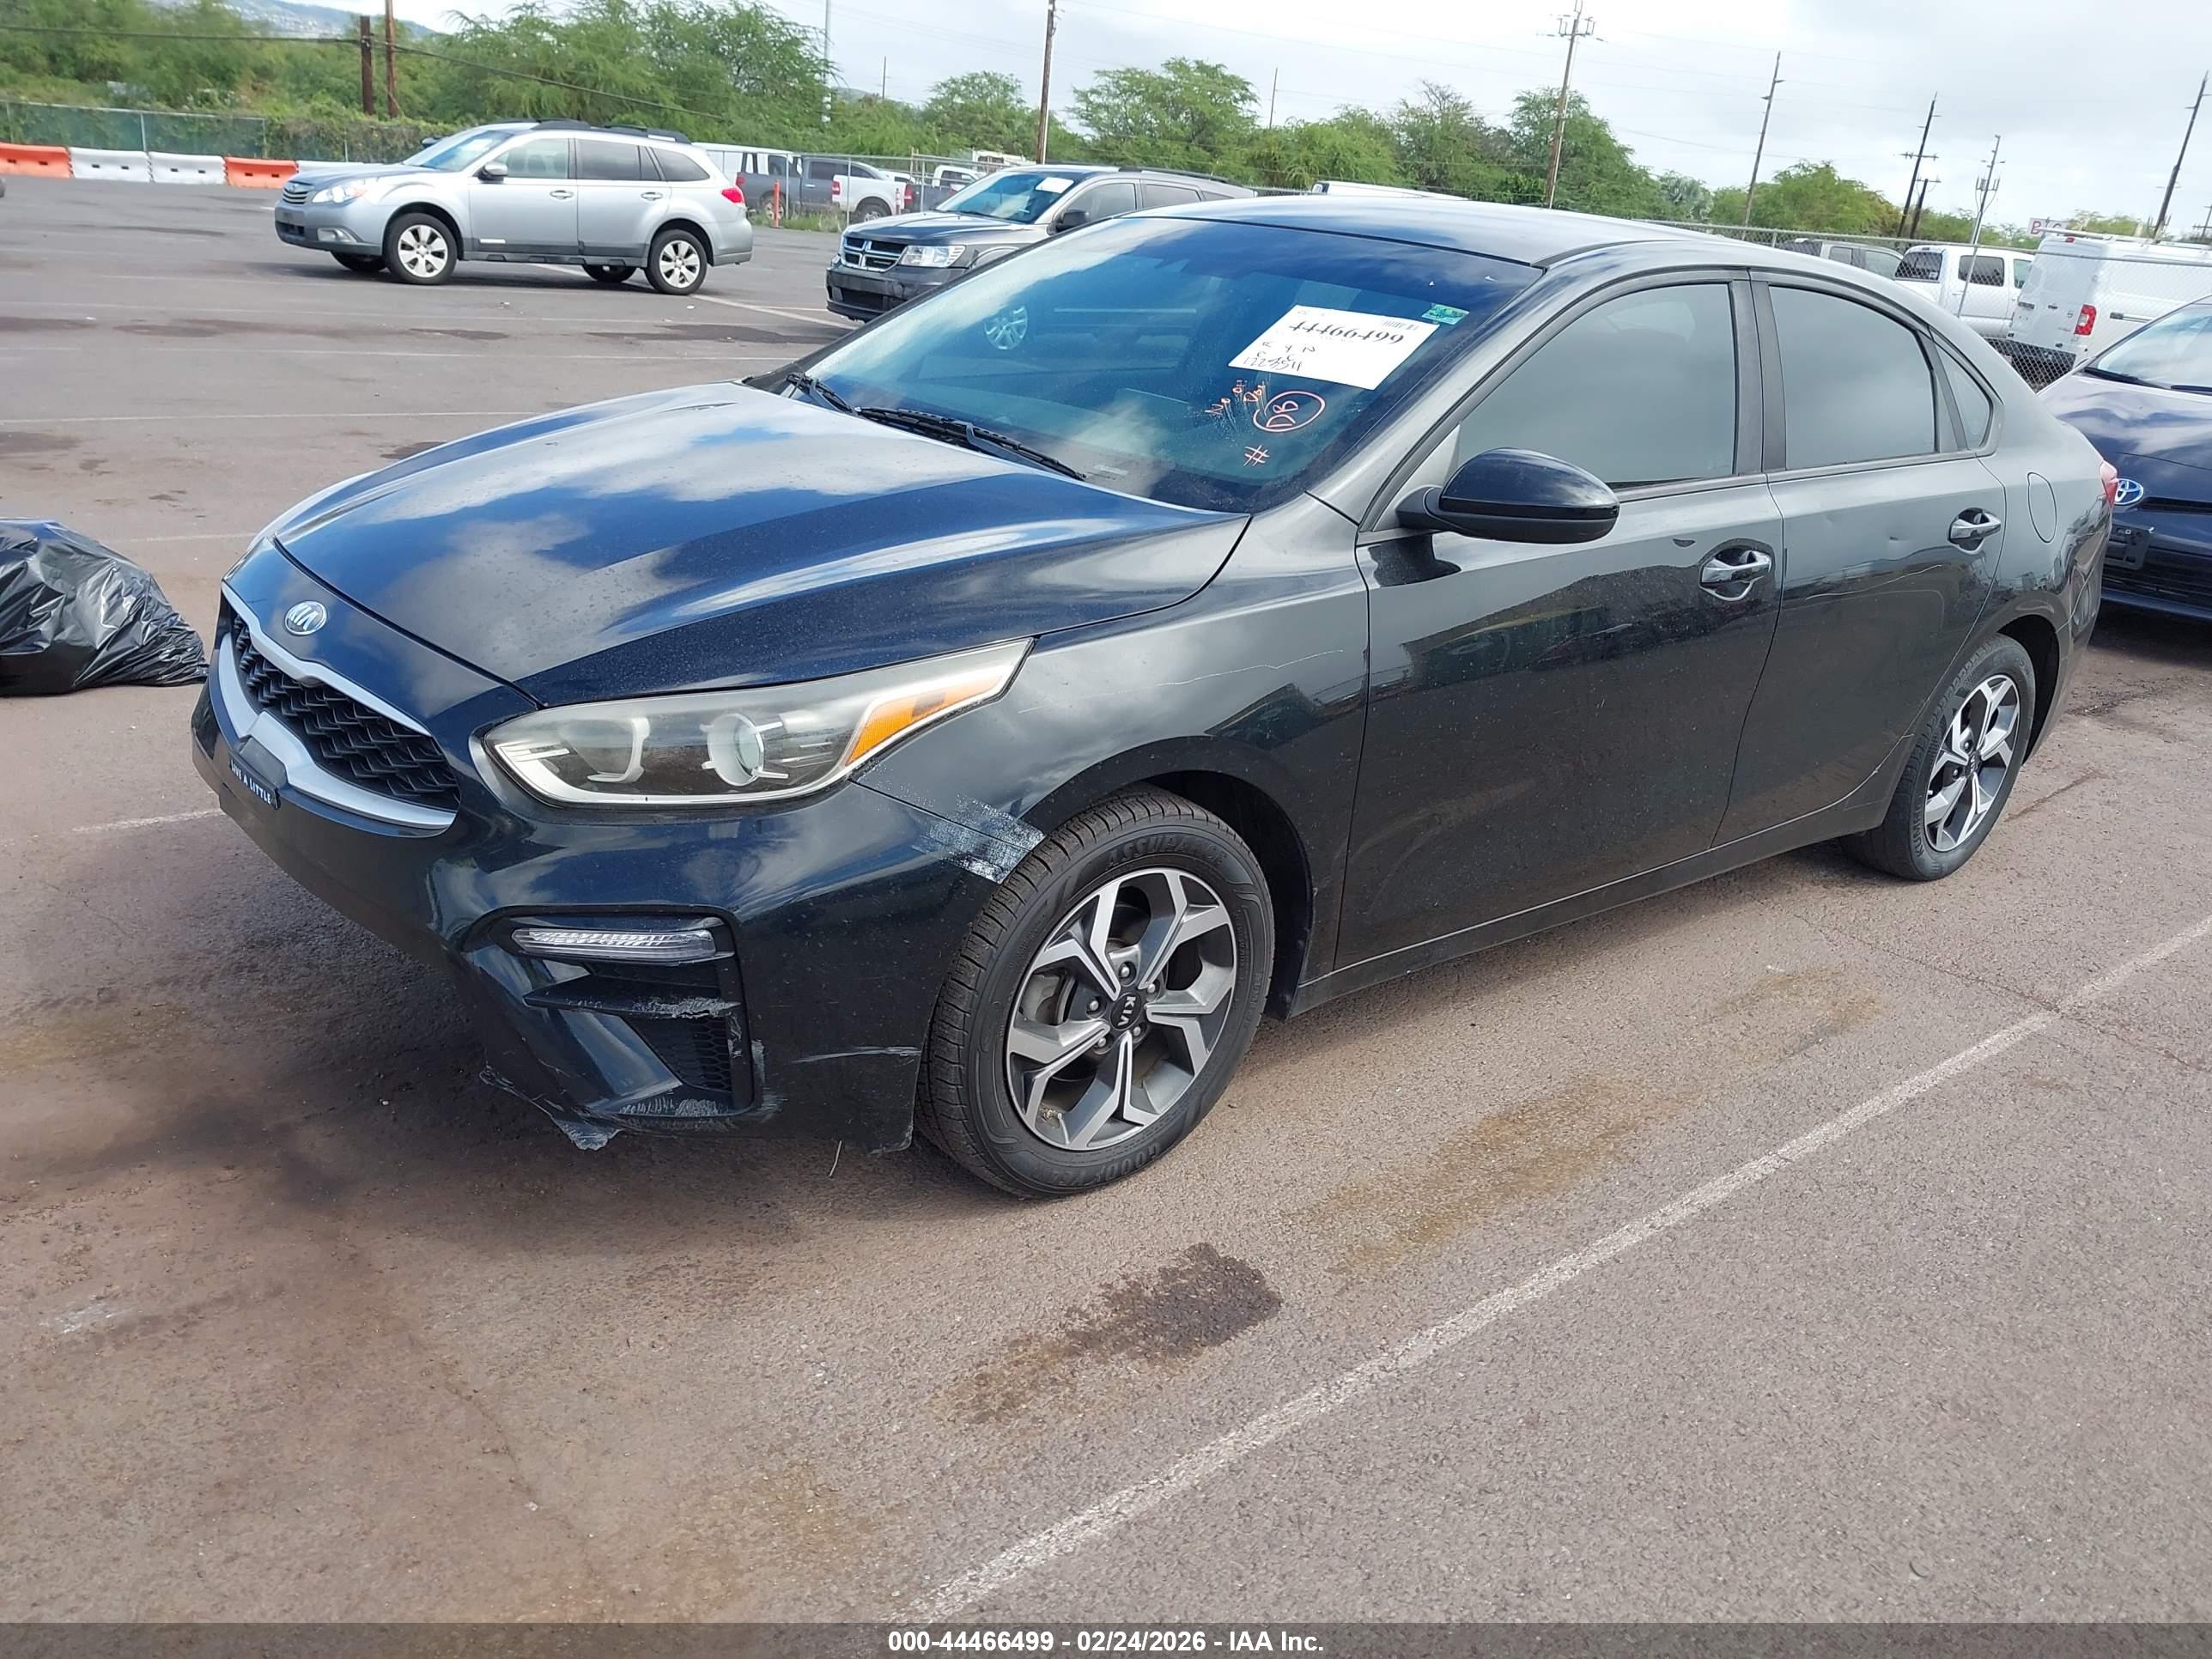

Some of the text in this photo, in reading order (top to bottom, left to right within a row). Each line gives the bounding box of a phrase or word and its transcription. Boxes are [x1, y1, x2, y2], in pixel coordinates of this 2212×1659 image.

[1289, 321, 1405, 343] 44466499
[249, 777, 272, 805] LITTLE
[1117, 996, 1137, 1026] KIA
